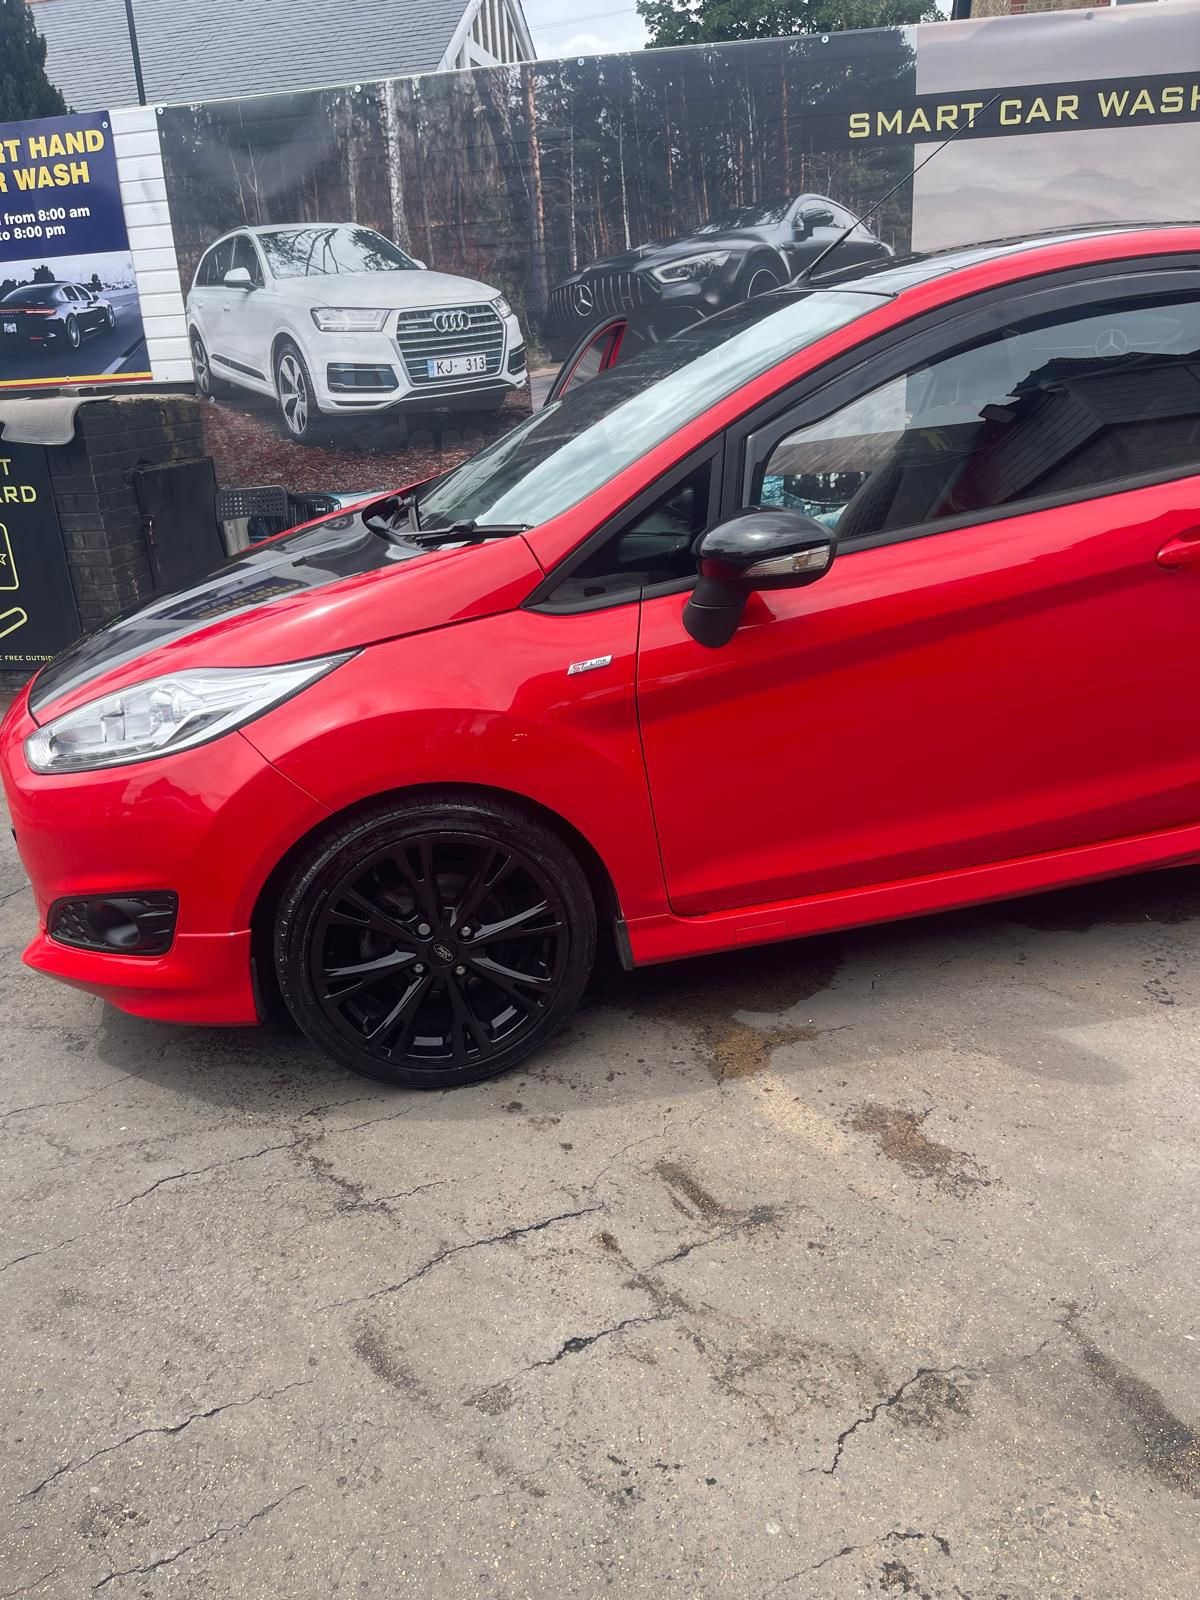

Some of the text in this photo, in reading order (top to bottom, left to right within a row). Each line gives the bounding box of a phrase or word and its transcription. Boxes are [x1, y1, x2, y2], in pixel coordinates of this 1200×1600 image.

[848, 102, 983, 138] SMART
[1000, 95, 1079, 125] CAR
[28, 129, 105, 159] HAND
[13, 161, 90, 190] WASH
[4, 213, 36, 225] from
[37, 207, 66, 221] 8:00
[69, 207, 91, 218] am
[13, 225, 43, 239] 8:00
[45, 225, 66, 239] pm
[466, 357, 485, 371] 313
[0, 485, 37, 503] RD
